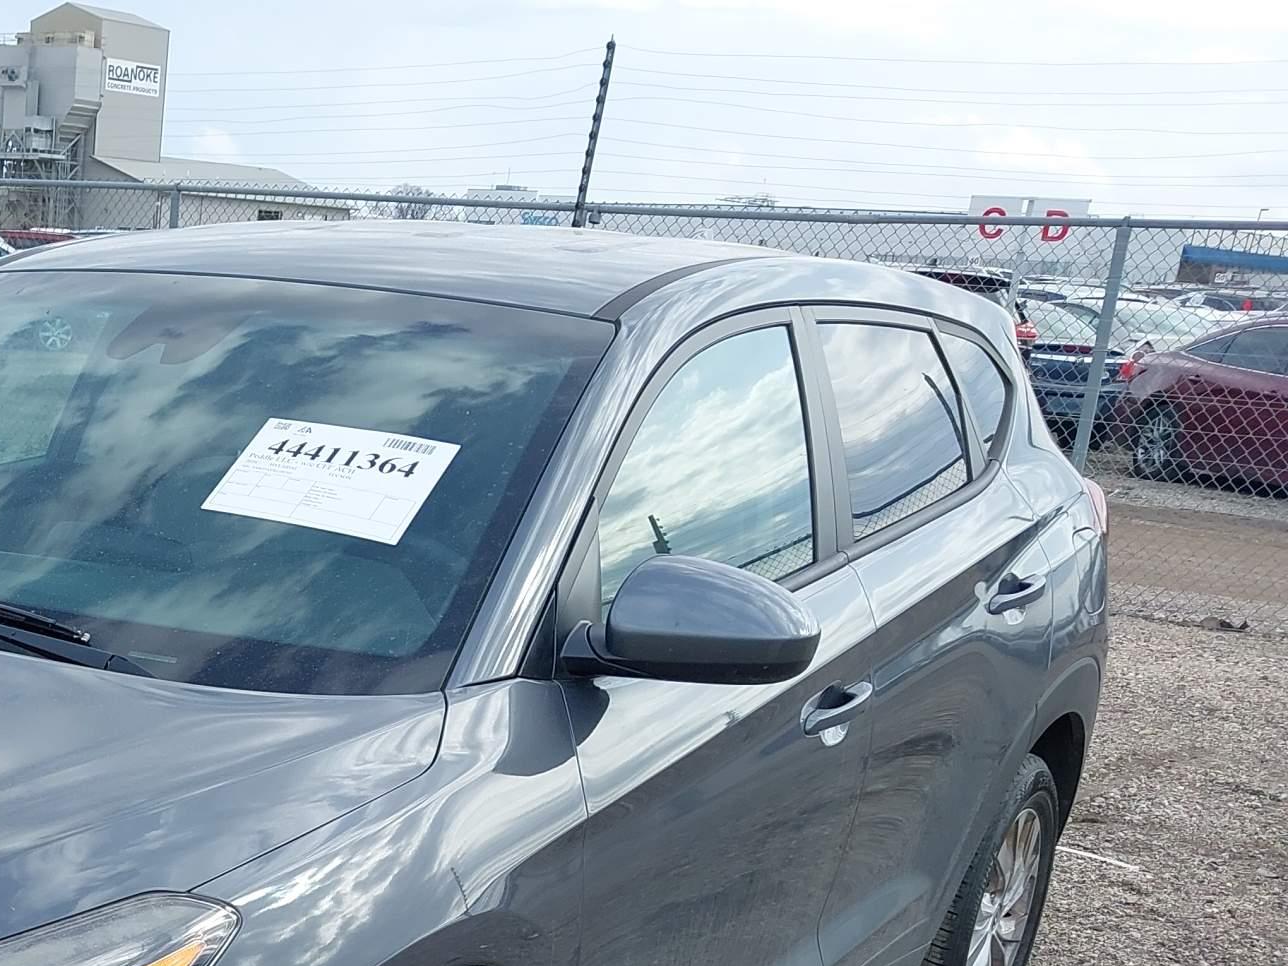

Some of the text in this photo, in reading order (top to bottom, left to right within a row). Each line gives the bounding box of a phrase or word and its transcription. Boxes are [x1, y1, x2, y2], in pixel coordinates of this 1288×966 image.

[107, 81, 158, 95] CONCRETE PRODUCTS
[108, 64, 159, 84] ROANOKE
[979, 207, 1006, 239] C
[1041, 210, 1069, 241] D
[267, 439, 420, 478] 44411364
